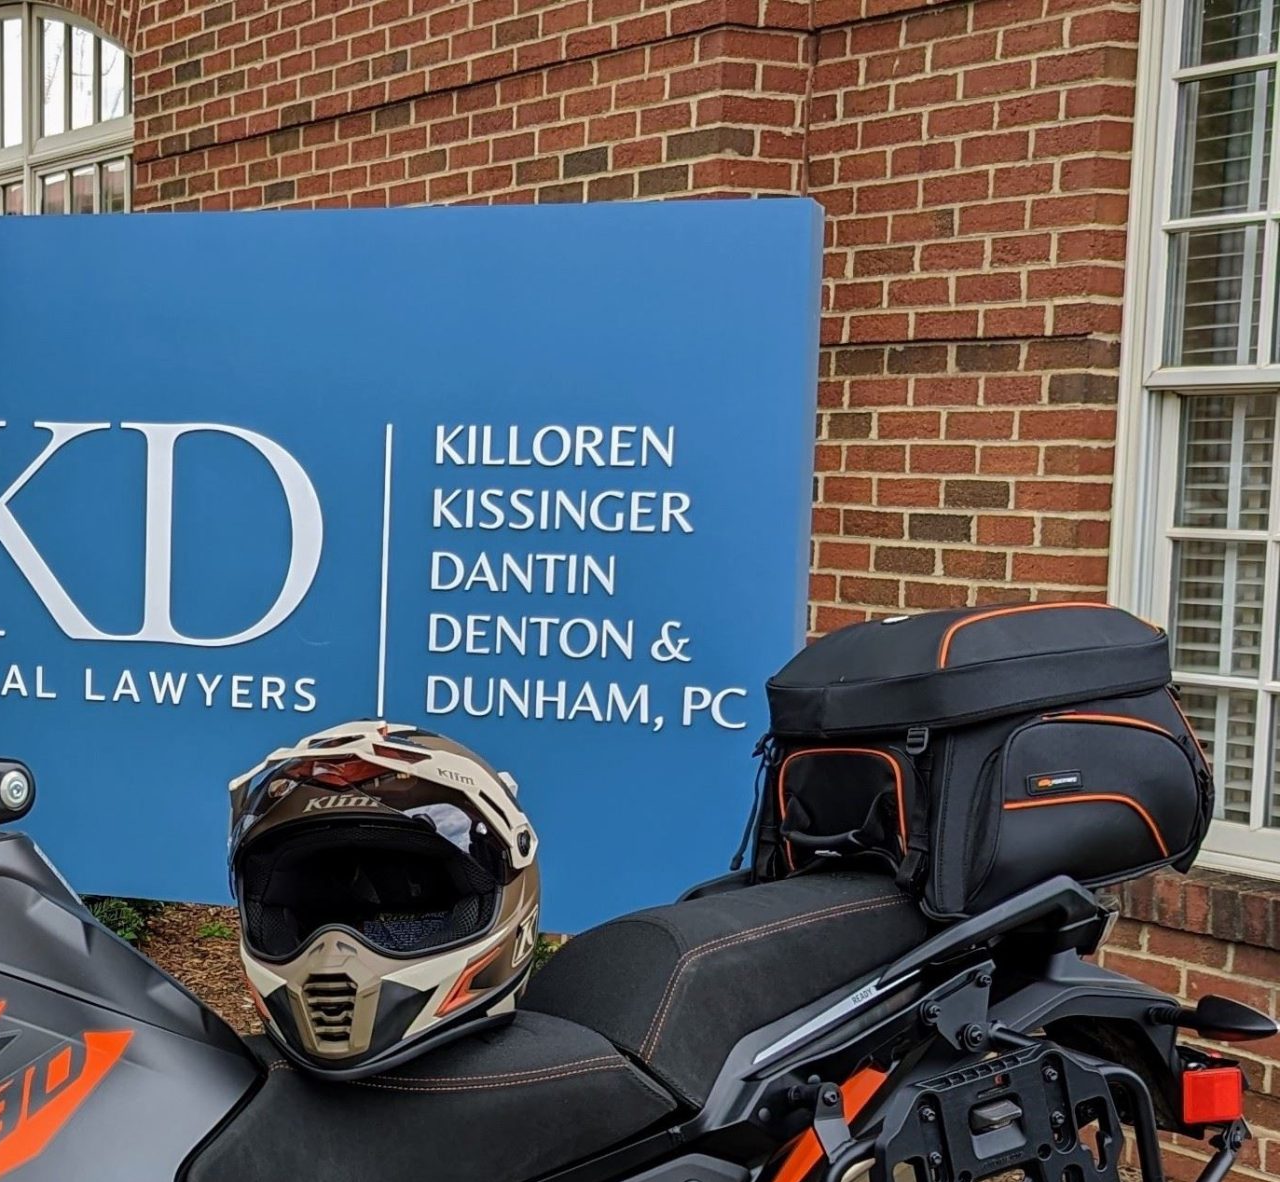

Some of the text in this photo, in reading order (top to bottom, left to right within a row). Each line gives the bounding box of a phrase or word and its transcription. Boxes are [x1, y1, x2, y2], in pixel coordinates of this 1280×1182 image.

[434, 424, 675, 468] KILLOREN
[432, 488, 695, 533] KISSINGER
[430, 551, 616, 596] DANTIN
[428, 613, 692, 662] DENTON &
[85, 667, 317, 713] LAWYERS
[425, 674, 748, 732] DUNHAM, PC
[851, 987, 874, 1005] READY
